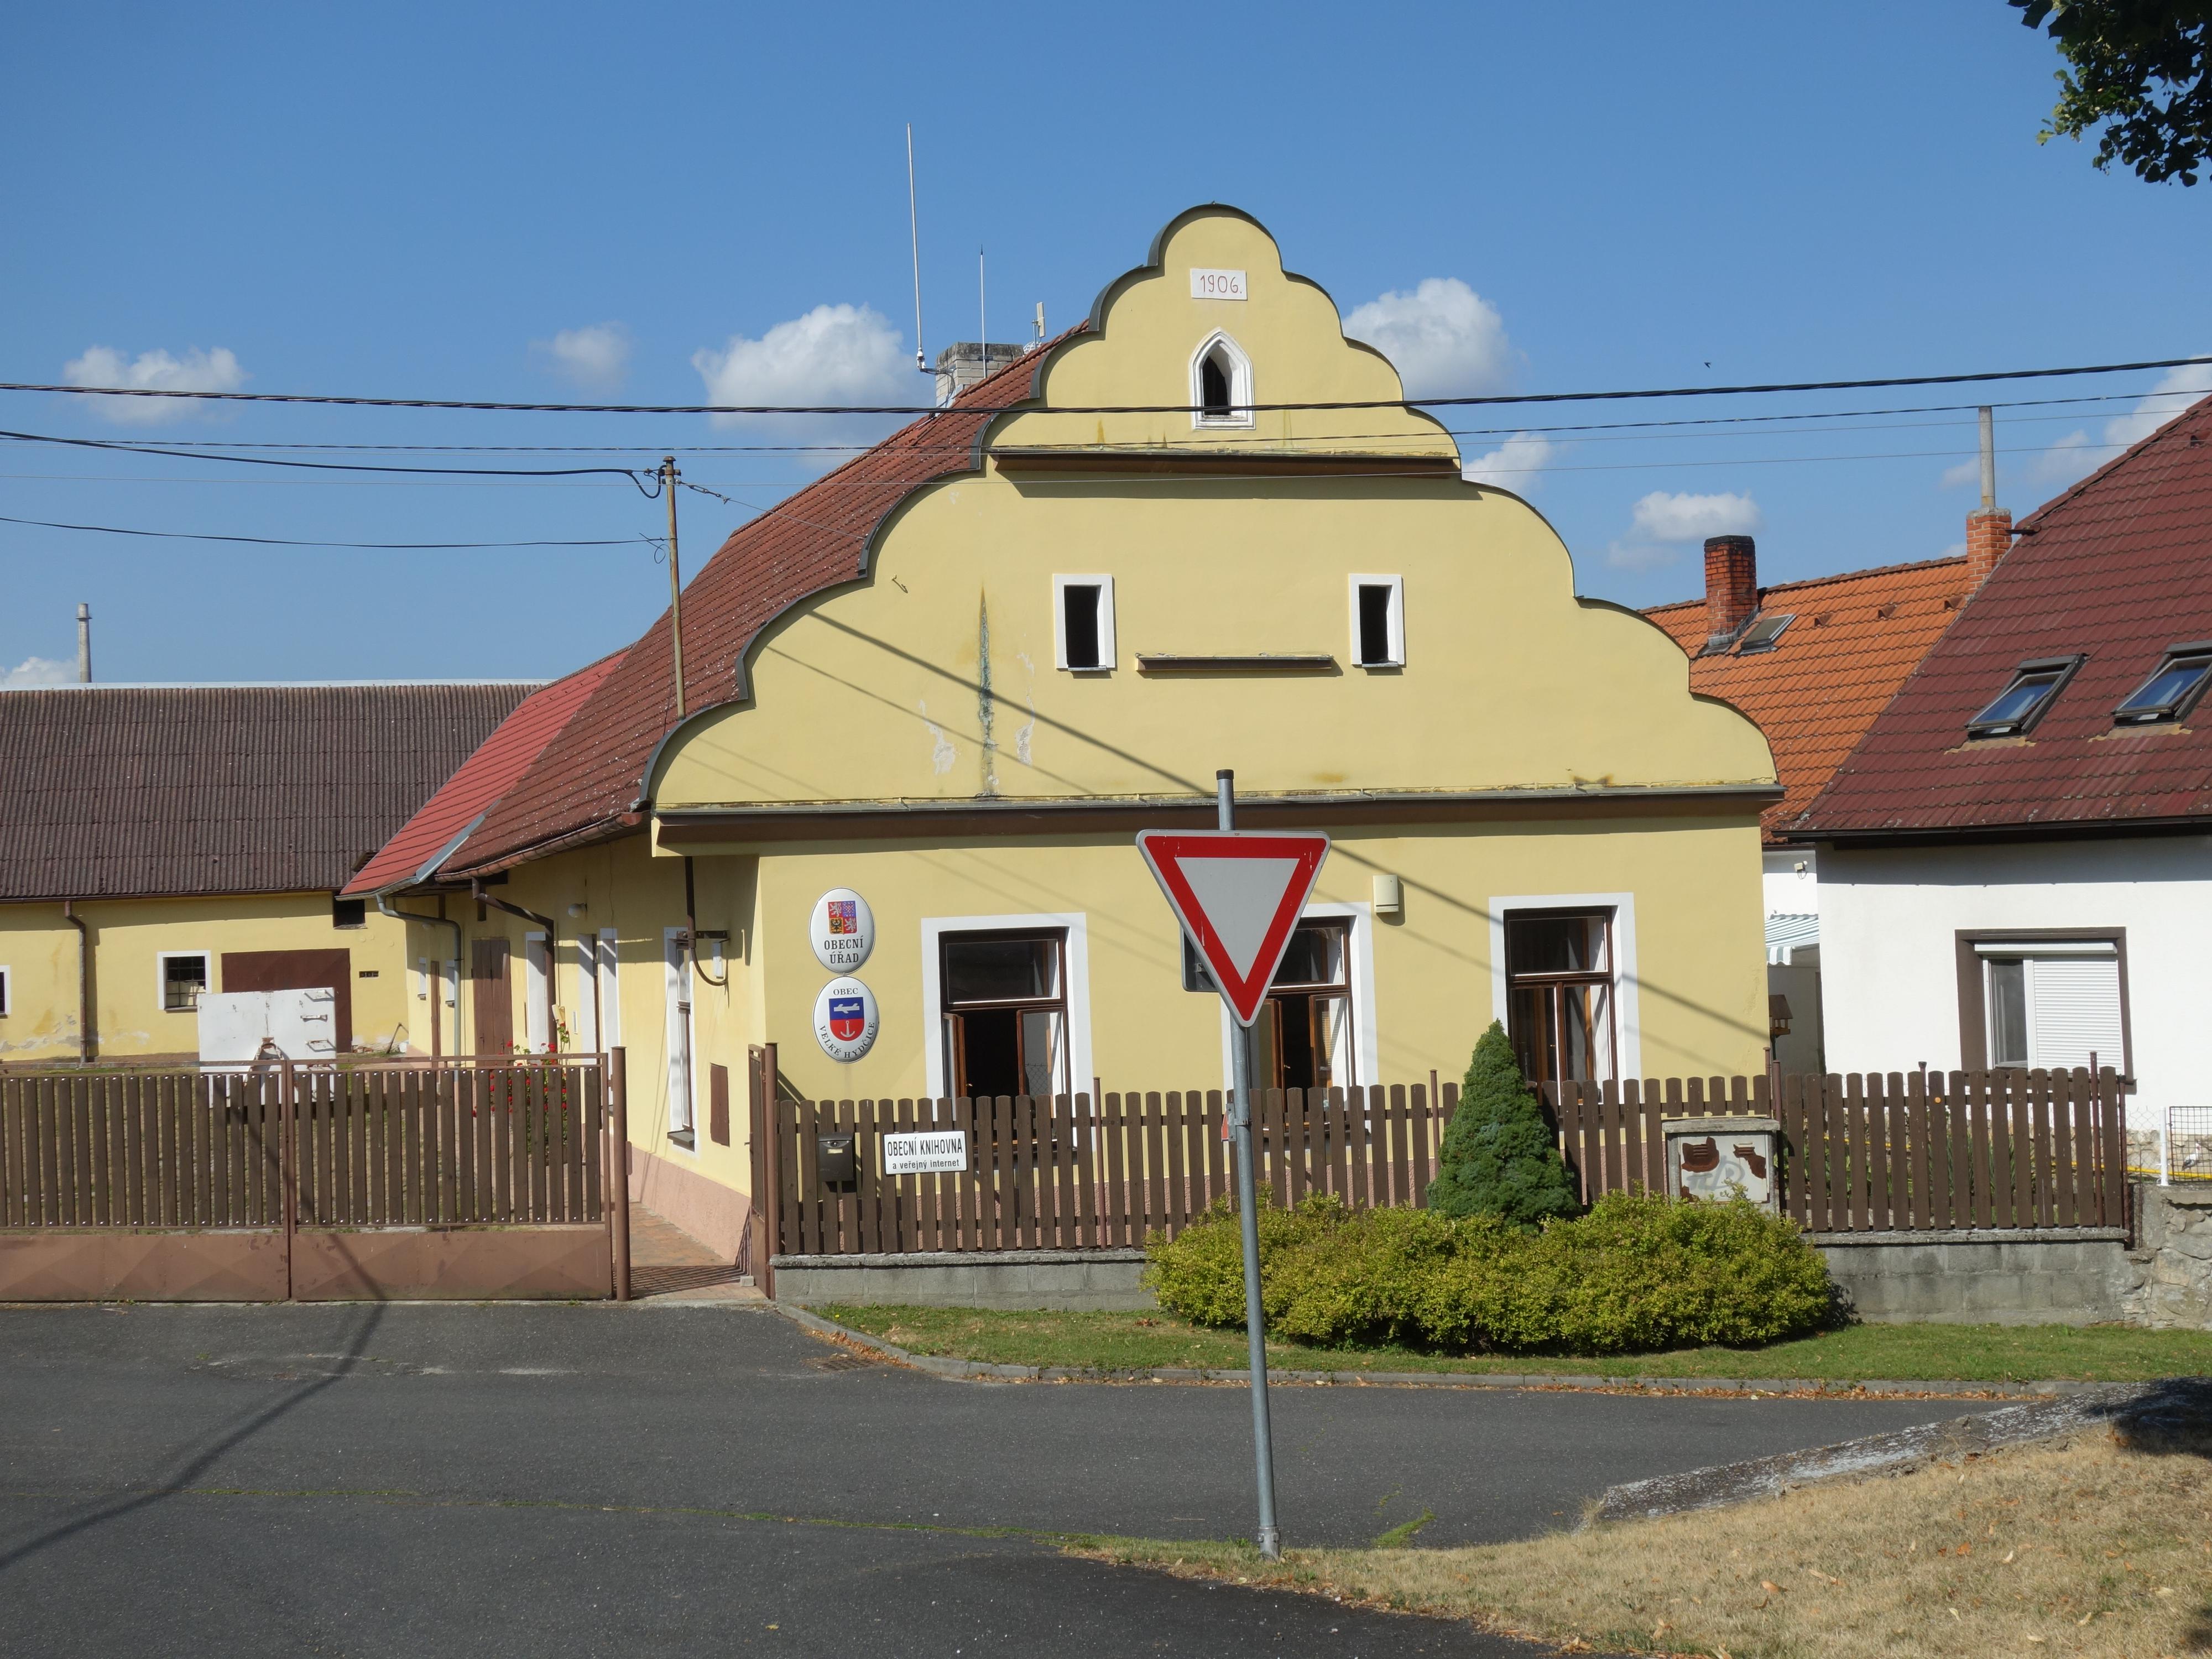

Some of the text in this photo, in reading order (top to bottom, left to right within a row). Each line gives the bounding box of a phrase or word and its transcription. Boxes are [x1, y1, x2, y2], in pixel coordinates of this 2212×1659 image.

[824, 936, 864, 950] OBECNÍ
[830, 951, 859, 964] ÚŘAD
[820, 1021, 875, 1058] VELKÉ HYDČICE
[887, 1137, 963, 1156] OBECNÍ KNIHOVNA
[899, 1160, 927, 1170] veřejný
[930, 1159, 959, 1167] internet
